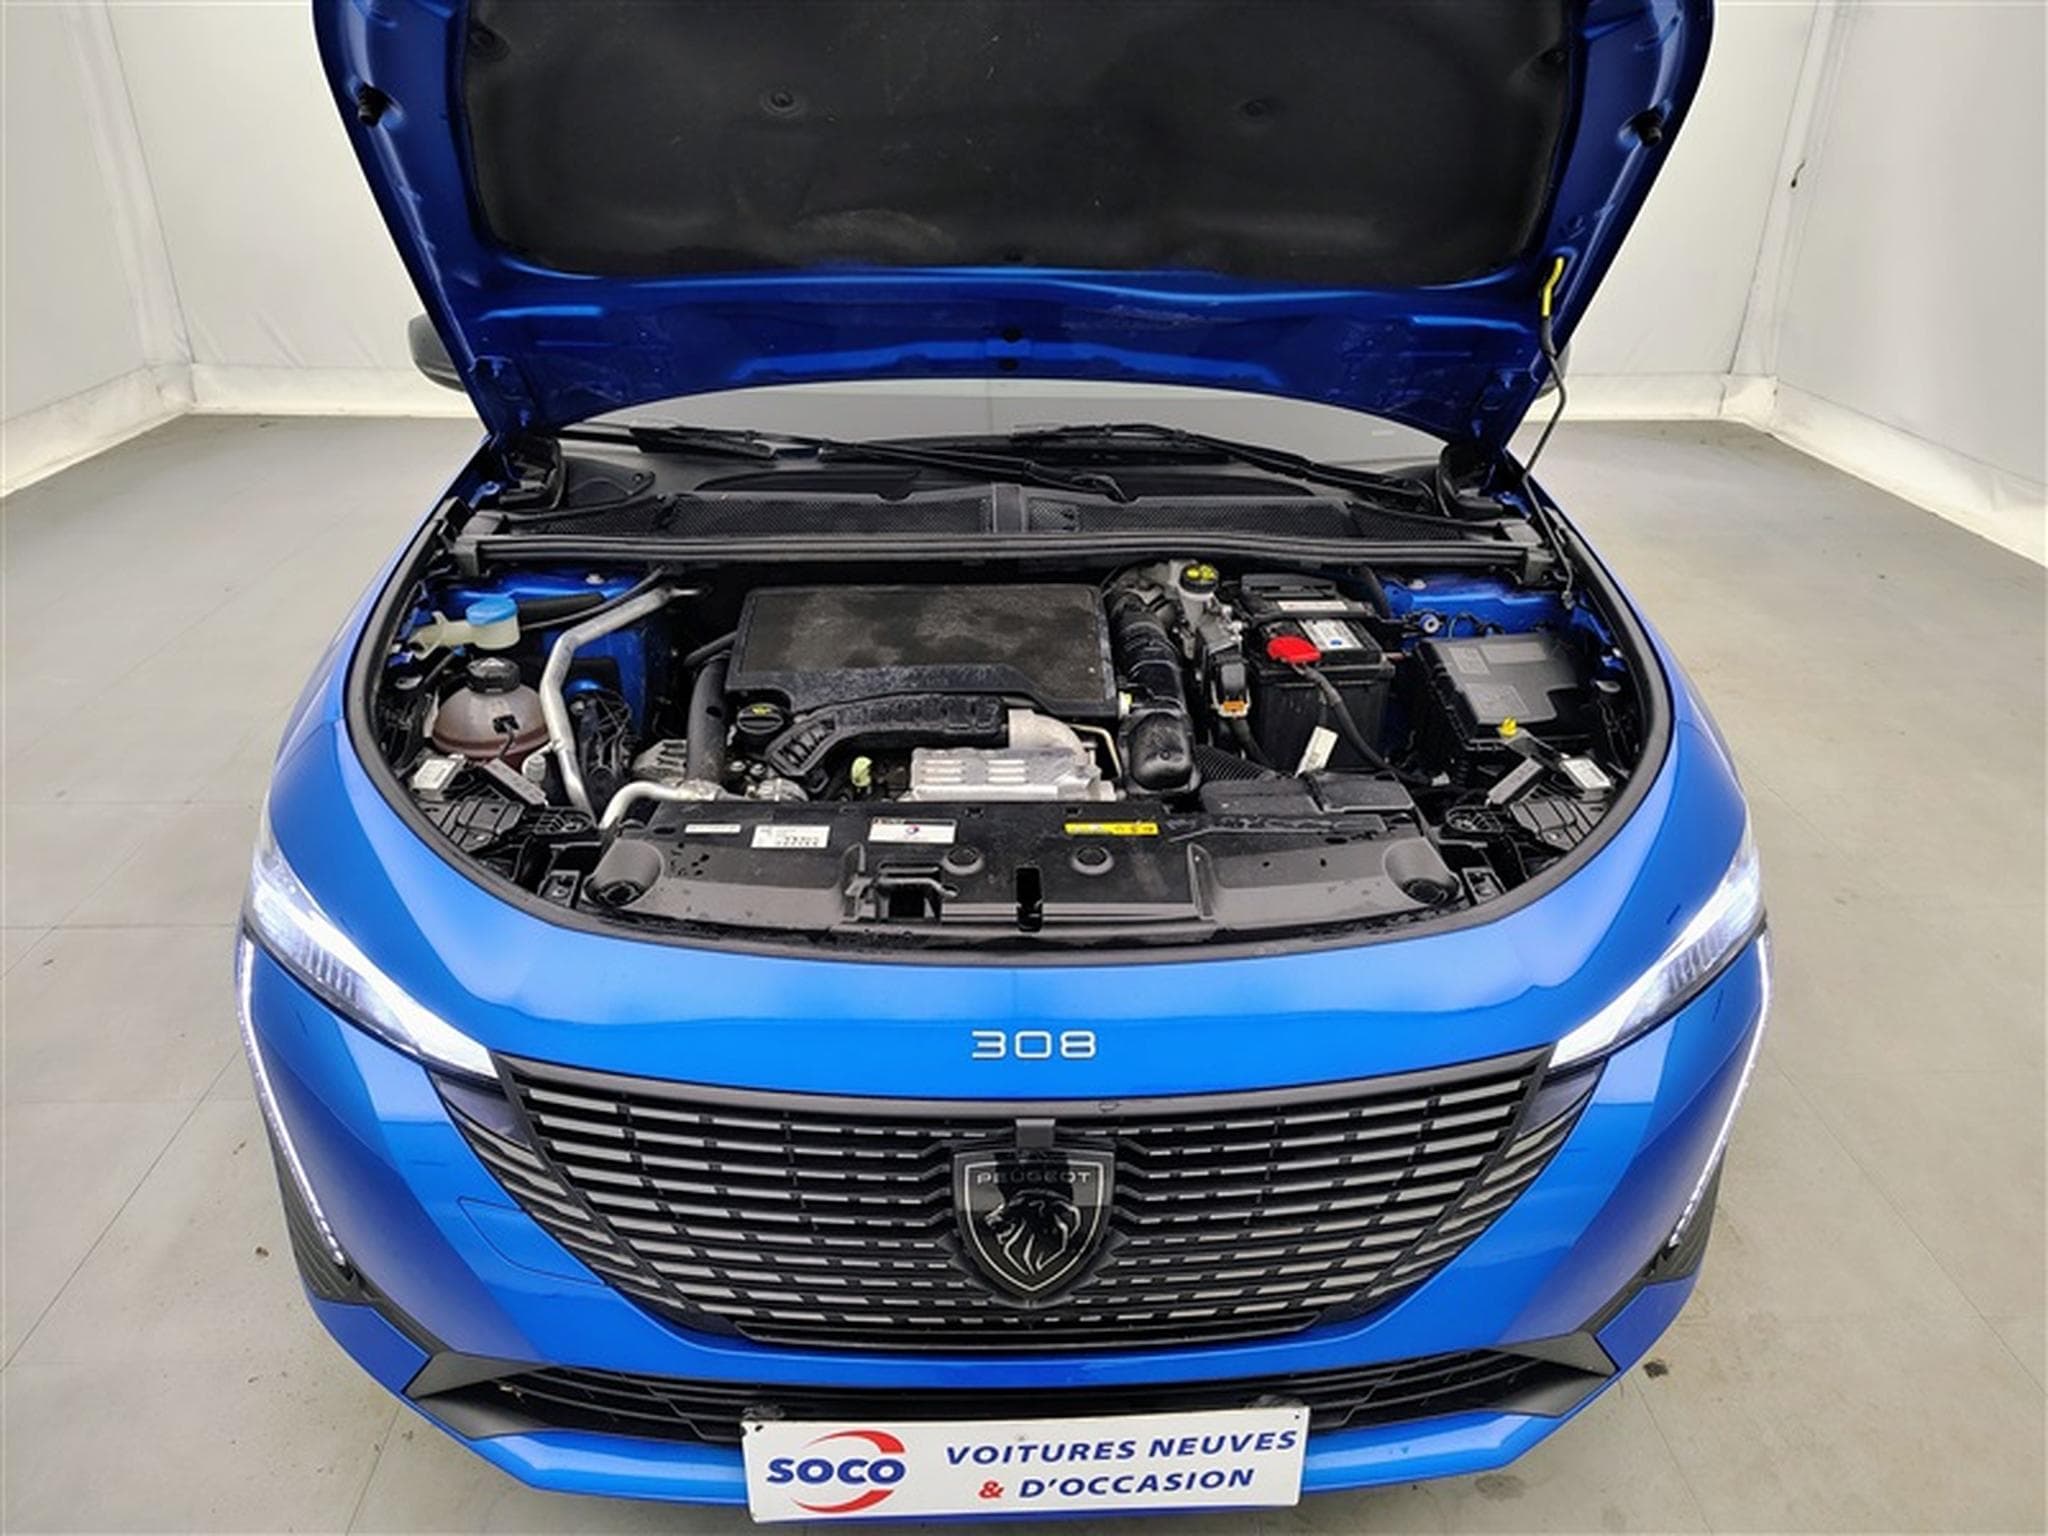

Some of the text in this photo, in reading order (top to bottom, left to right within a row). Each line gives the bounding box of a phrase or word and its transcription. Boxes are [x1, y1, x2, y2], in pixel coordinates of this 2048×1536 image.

[971, 1030, 1097, 1059] 308
[976, 1171, 1092, 1184] PEUGEOT
[946, 1430, 1298, 1465] VOITURES NEUVES
[766, 1457, 906, 1485] SOCO
[977, 1468, 1256, 1500] & D'OCCASION
